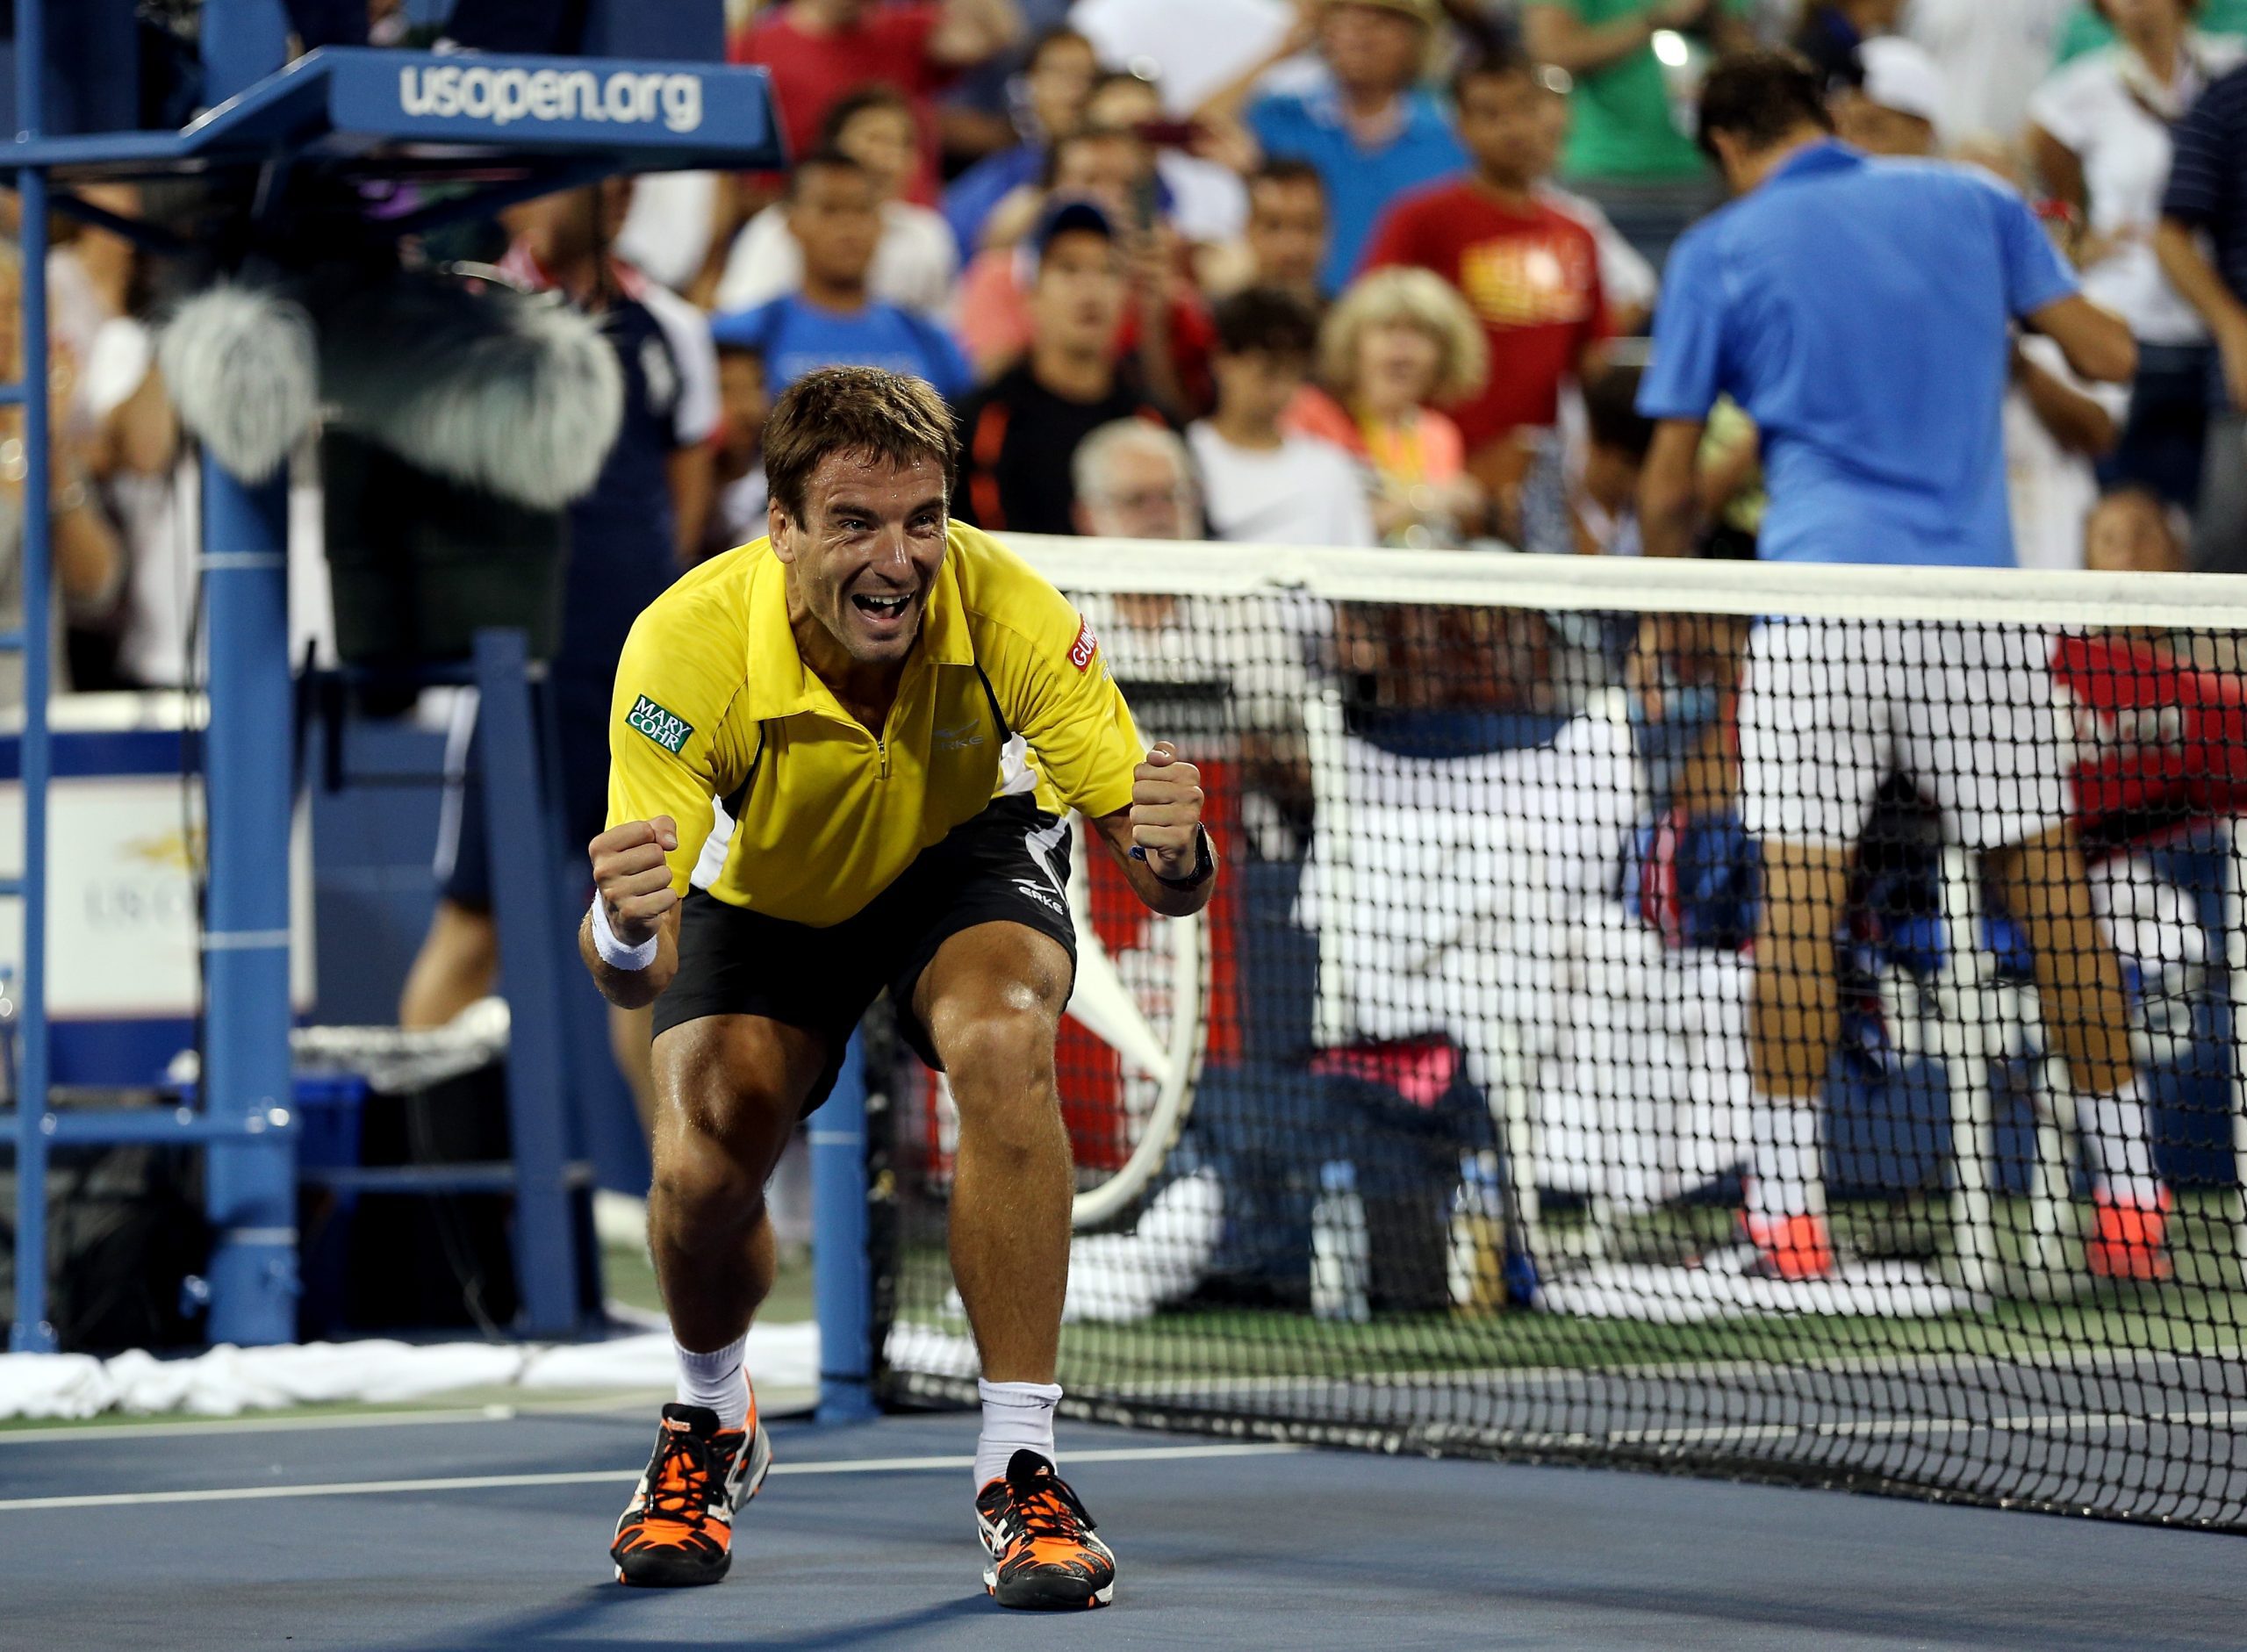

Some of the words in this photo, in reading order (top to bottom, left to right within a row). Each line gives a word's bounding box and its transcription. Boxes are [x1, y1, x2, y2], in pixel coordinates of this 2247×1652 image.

[399, 65, 700, 133] usopen.org
[629, 711, 679, 752] COHR
[635, 696, 692, 737] MARY
[1018, 886, 1064, 916] ERKE
